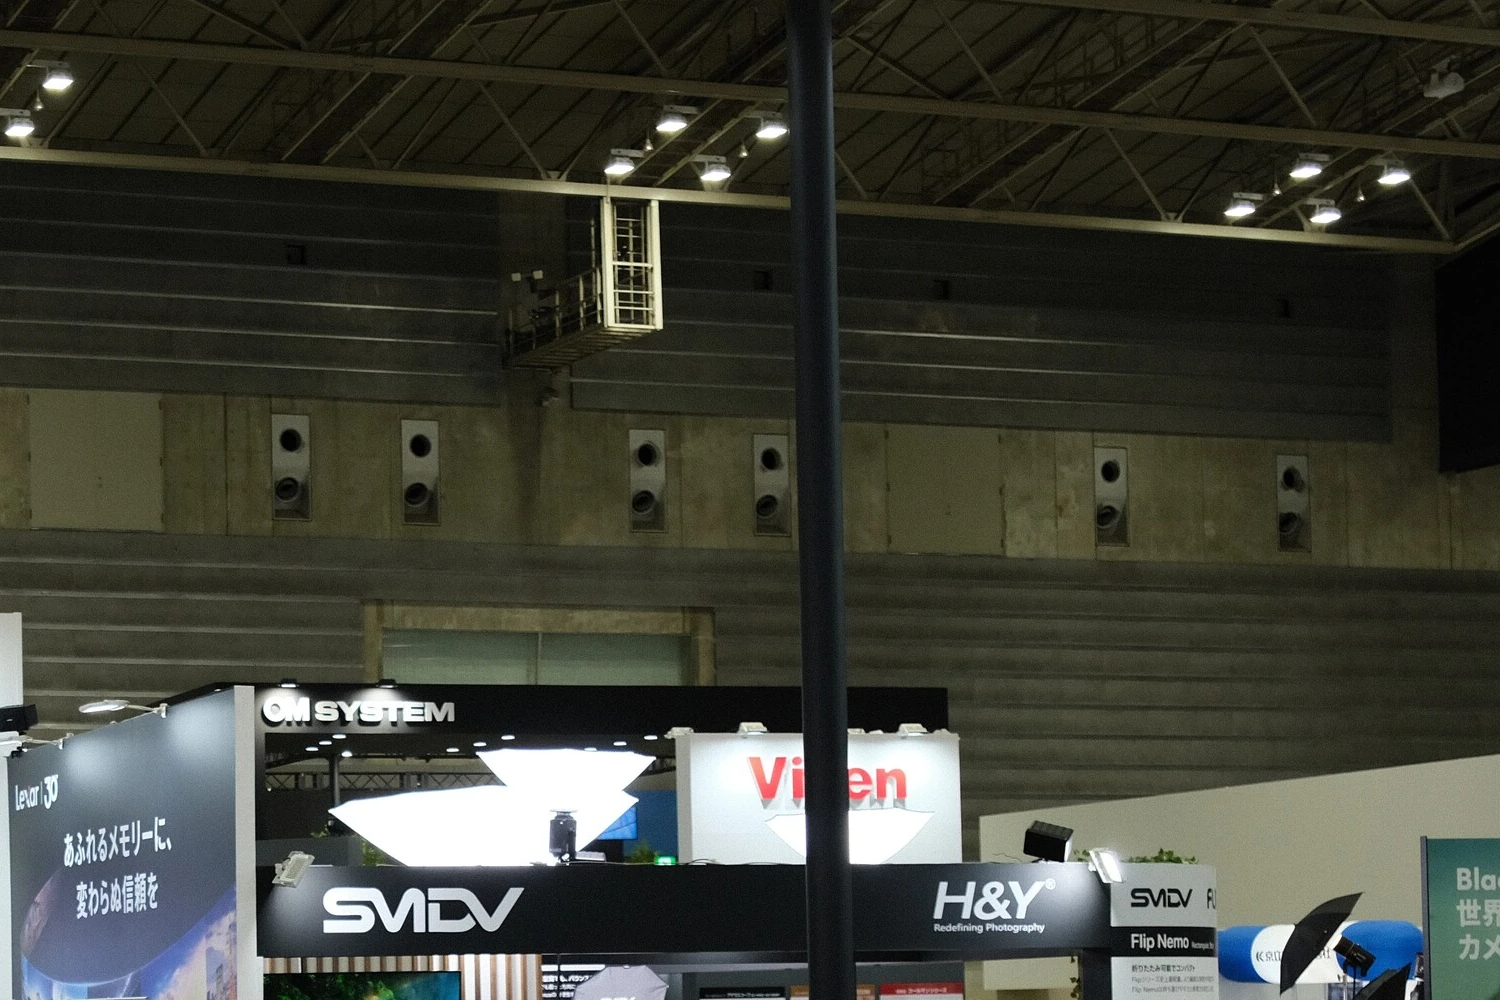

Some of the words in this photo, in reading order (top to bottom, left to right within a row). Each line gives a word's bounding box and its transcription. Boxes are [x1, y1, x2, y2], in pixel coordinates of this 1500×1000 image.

[263, 696, 311, 723] OM
[315, 701, 455, 722] SYSTEM
[748, 756, 907, 800] Vien
[15, 785, 39, 811] Lexar
[64, 816, 172, 867] あふれるメモリーに、
[1456, 867, 1500, 891] Bla
[76, 872, 159, 919] 変わらぬ信頼を
[1130, 888, 1193, 908] SMDV
[323, 887, 525, 933] SMDV
[934, 923, 984, 934] Redefining
[985, 922, 1045, 934] Photography
[1130, 933, 1155, 952] Flip
[1157, 933, 1190, 949] Nemo
